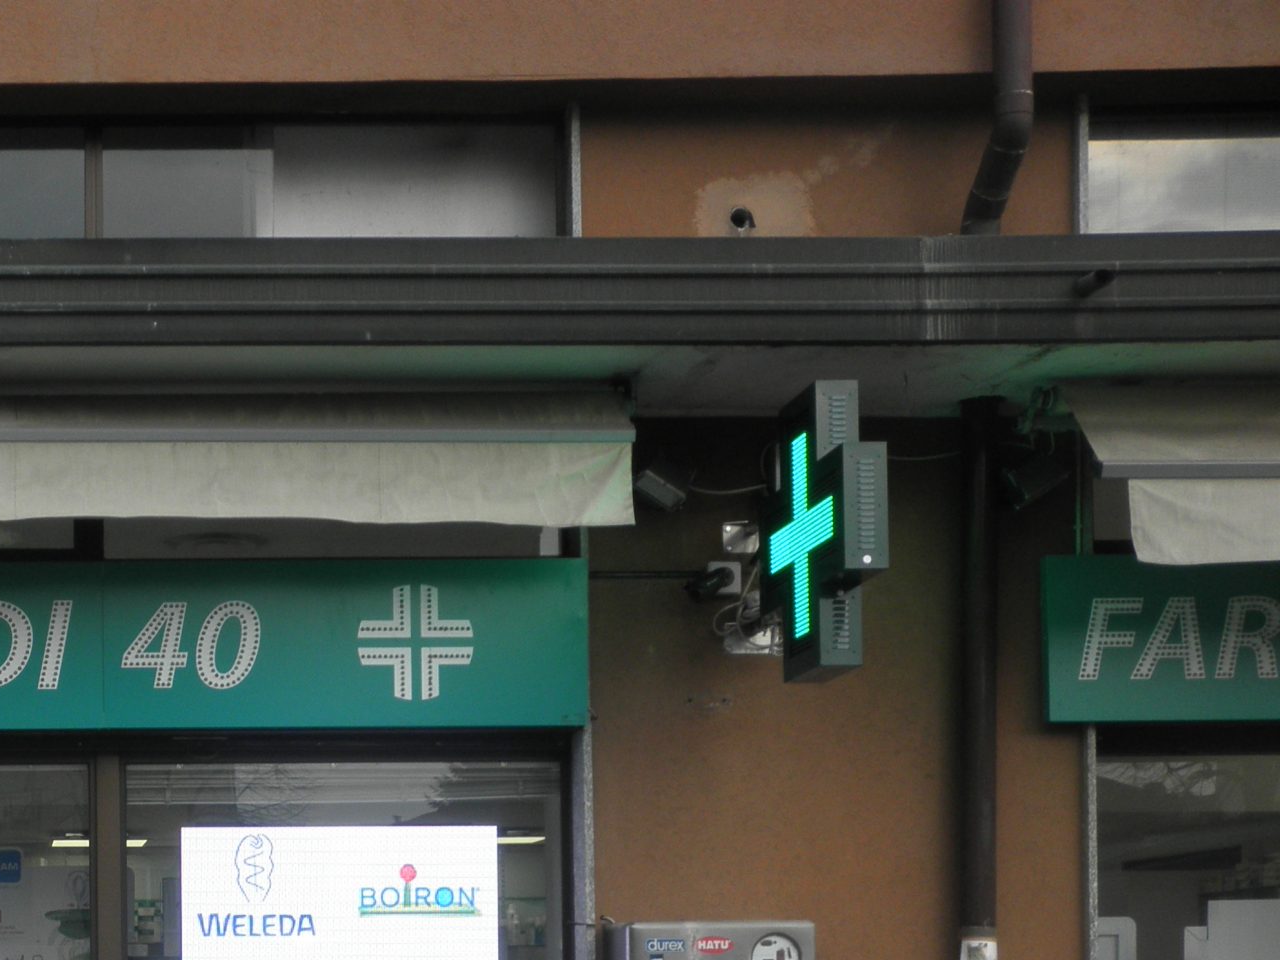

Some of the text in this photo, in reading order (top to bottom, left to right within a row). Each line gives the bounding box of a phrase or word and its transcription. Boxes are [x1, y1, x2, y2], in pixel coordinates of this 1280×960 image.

[121, 600, 261, 689] 40
[359, 870, 478, 908] BOIRON
[197, 913, 316, 937] WELEDA
[647, 938, 685, 952] durex
